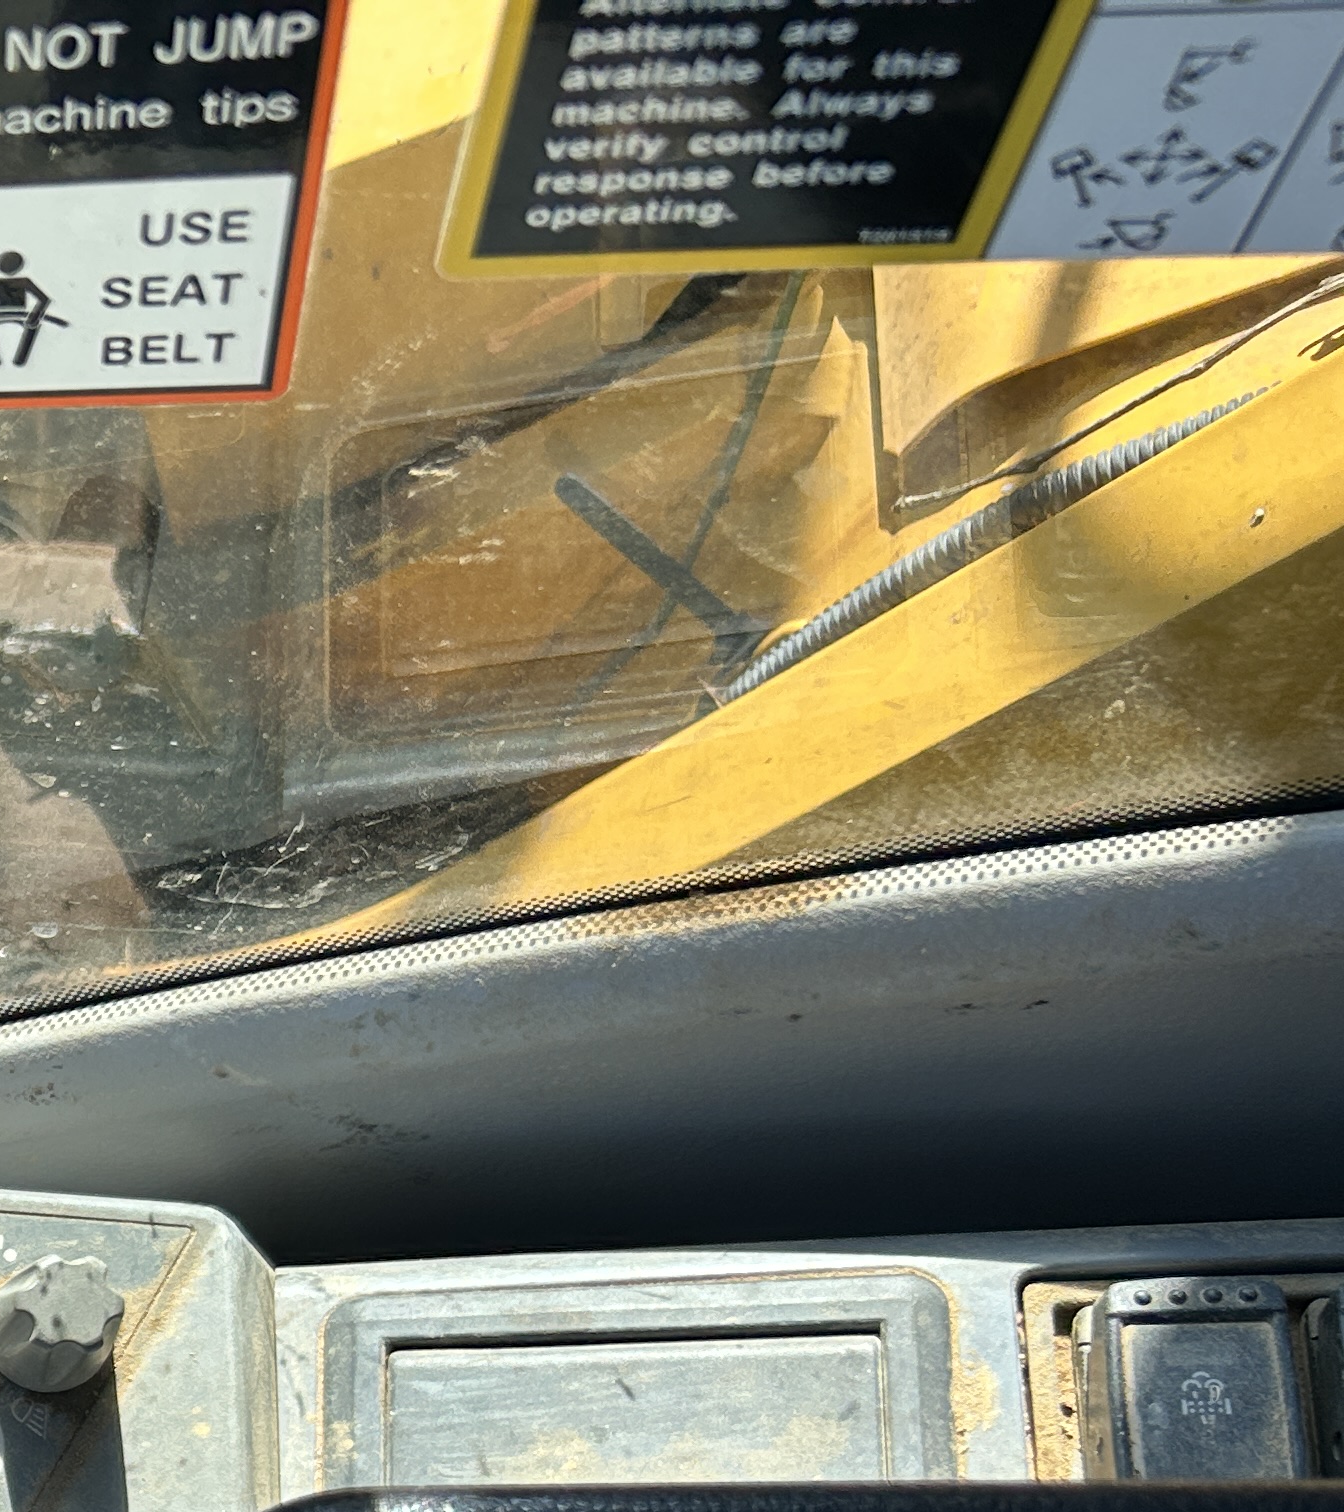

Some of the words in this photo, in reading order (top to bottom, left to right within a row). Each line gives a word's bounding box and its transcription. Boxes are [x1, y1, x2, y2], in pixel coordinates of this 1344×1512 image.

[5, 21, 128, 73] NOT
[153, 10, 322, 65] JUMP
[567, 20, 760, 62] patterns
[778, 17, 860, 48] are
[559, 54, 763, 92] available
[781, 51, 854, 83] for
[871, 47, 962, 81] this
[202, 88, 300, 129] tips
[551, 92, 751, 127] machine.
[769, 87, 936, 122] Always
[543, 129, 669, 164] verify
[687, 123, 849, 158] control
[533, 165, 735, 197] response
[752, 158, 896, 189] before
[140, 210, 250, 247] USE
[524, 196, 739, 233] operating.
[100, 273, 243, 309] SEAT
[100, 332, 236, 366] BELT
